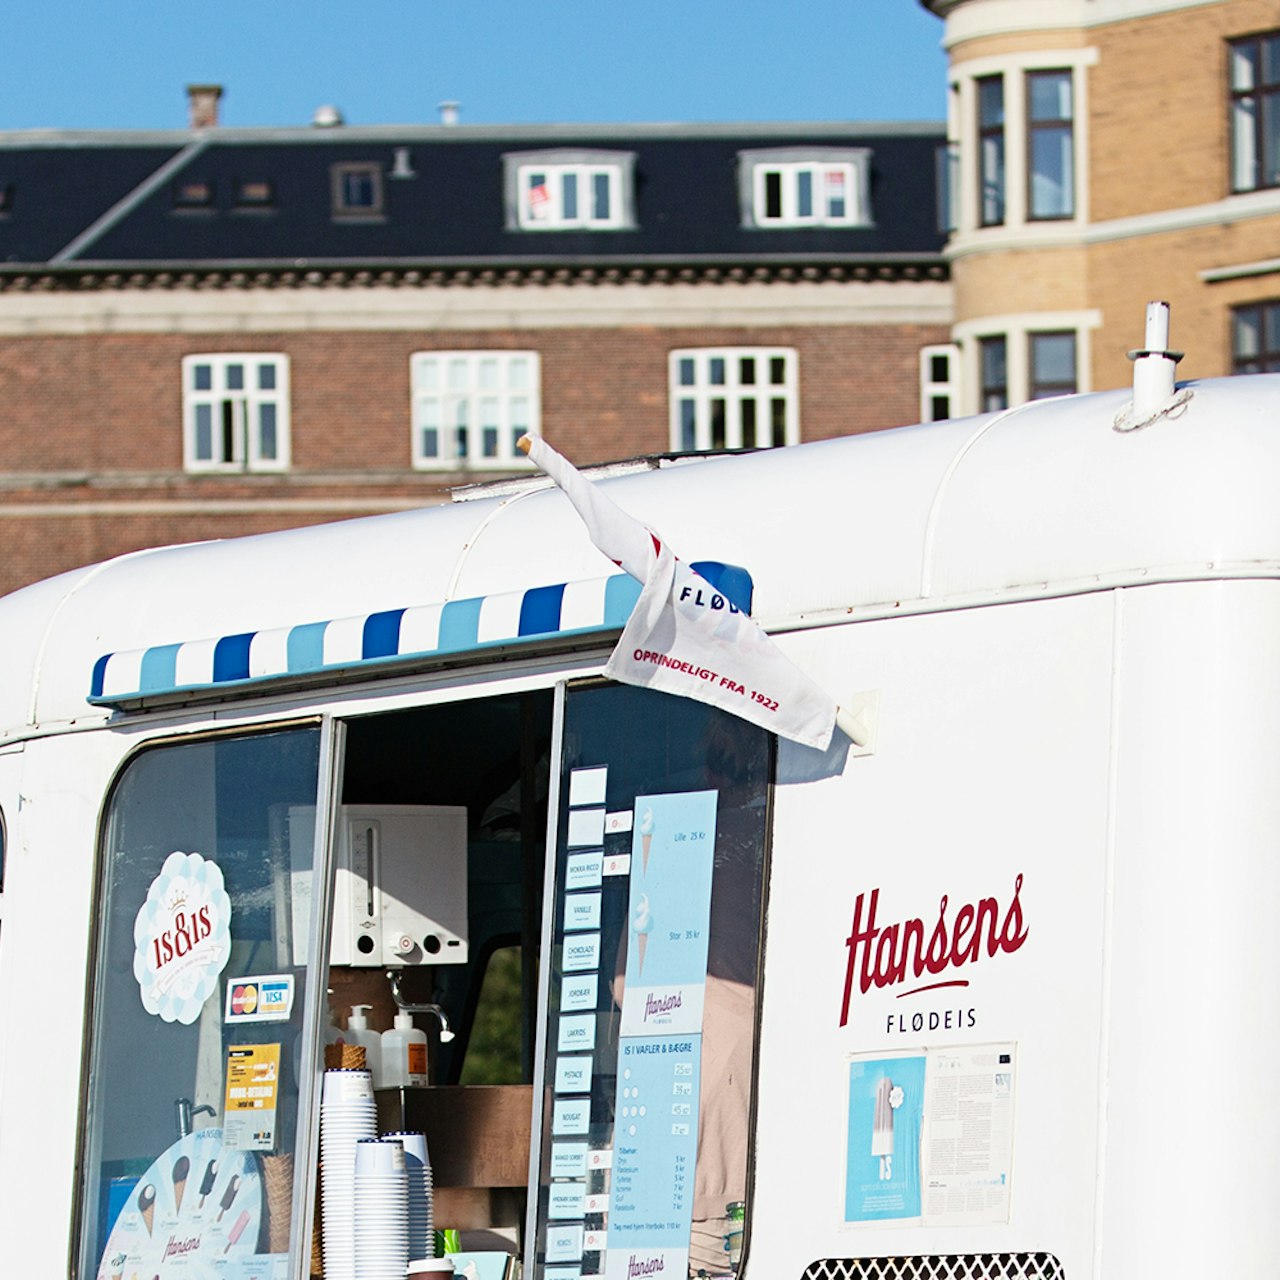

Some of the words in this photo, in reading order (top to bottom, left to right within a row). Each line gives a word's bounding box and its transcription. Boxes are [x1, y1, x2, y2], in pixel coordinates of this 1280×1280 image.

[633, 649, 719, 682] OPRINDELIGT
[719, 677, 745, 695] FRA
[750, 691, 780, 712] 1922
[690, 832, 697, 840] 25
[153, 905, 212, 970] IS&IS
[686, 930, 693, 939] 35
[839, 873, 1030, 1027] Hansens
[266, 992, 282, 1002] VISA
[644, 991, 682, 1023] Hansens
[887, 1008, 976, 1033] FLØDEIS
[624, 1045, 631, 1055] IS
[636, 1044, 660, 1055] VAFLER
[661, 1043, 666, 1053] &
[668, 1042, 692, 1053] BÆGRE
